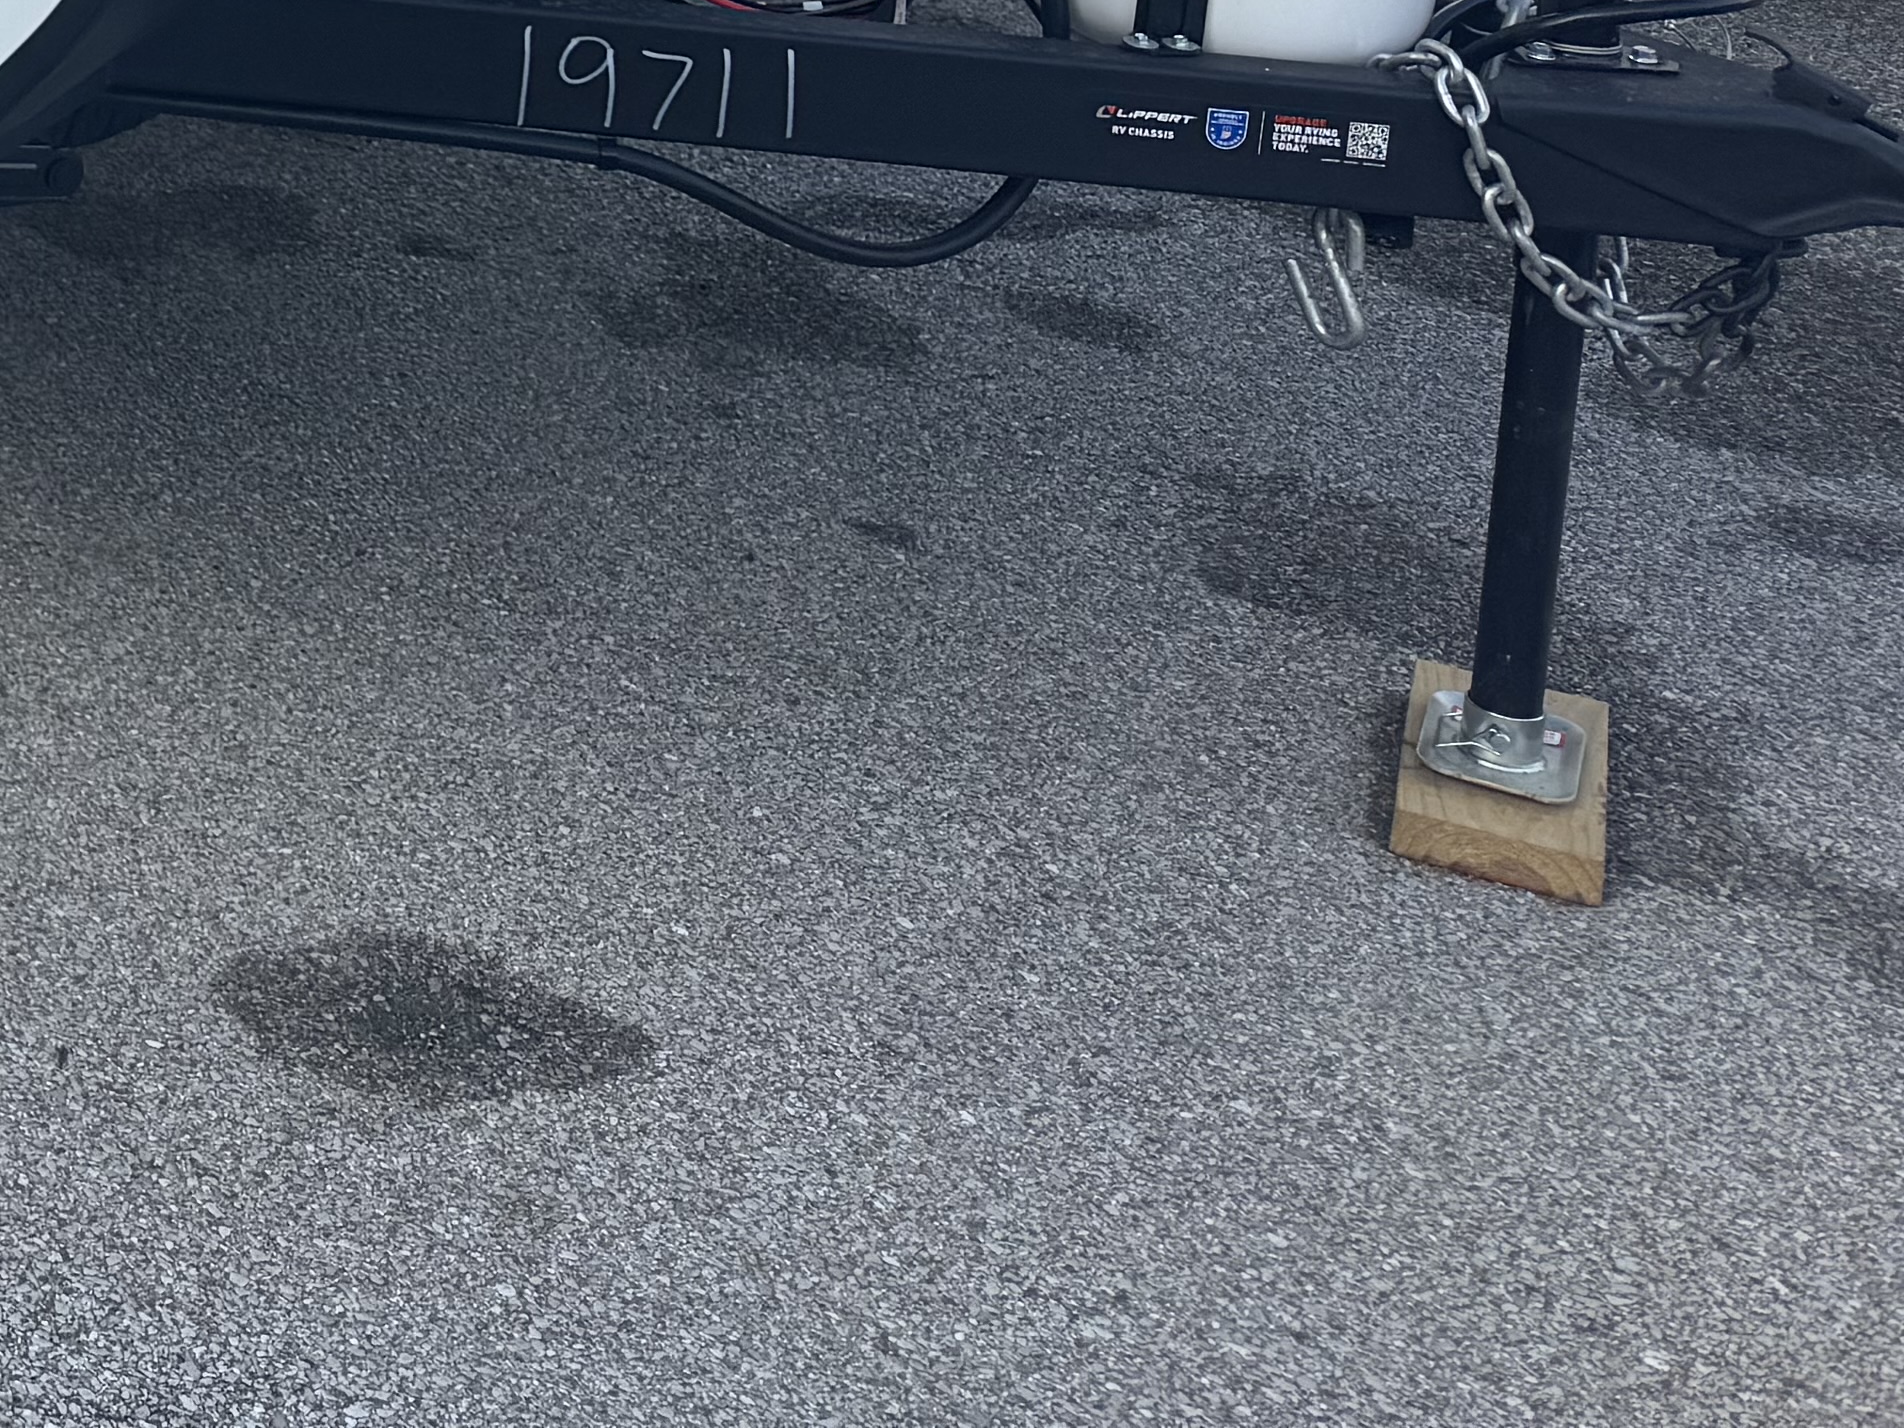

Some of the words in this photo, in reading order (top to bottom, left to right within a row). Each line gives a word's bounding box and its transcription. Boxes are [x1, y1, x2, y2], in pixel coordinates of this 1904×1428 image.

[517, 25, 795, 139] 19711
[1116, 108, 1198, 124] LIPPERT
[1111, 125, 1127, 135] RV
[1128, 127, 1175, 140] CHASSIS
[1273, 123, 1303, 135] YOUR
[1272, 132, 1342, 148] EXPERIENCE
[1272, 142, 1309, 154] TODAY.
